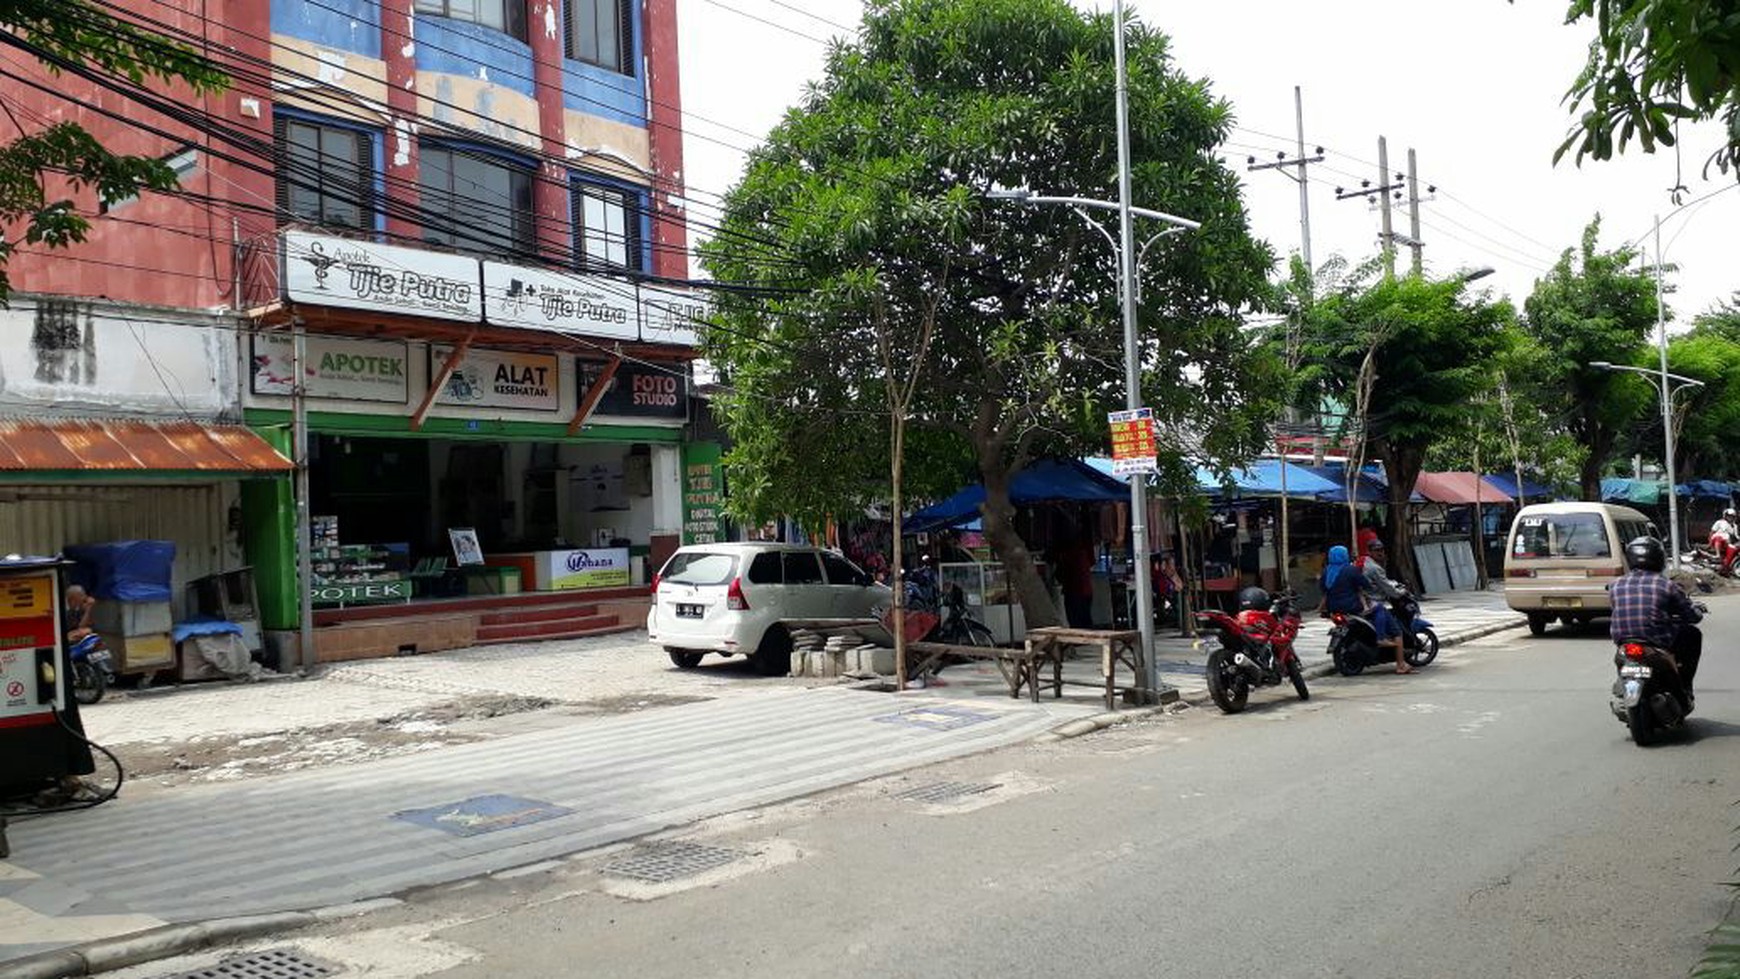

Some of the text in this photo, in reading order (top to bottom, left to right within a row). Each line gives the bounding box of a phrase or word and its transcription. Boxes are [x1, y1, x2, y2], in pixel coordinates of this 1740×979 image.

[333, 247, 371, 264] Apotek
[347, 263, 471, 303] Tjie Putra
[539, 293, 626, 324] Tjie Putra
[320, 351, 403, 376] APOTEK
[495, 363, 548, 386] ALAT
[632, 374, 676, 393] FOTO
[494, 385, 548, 397] KESEHATAN
[633, 392, 677, 406] STUDIO
